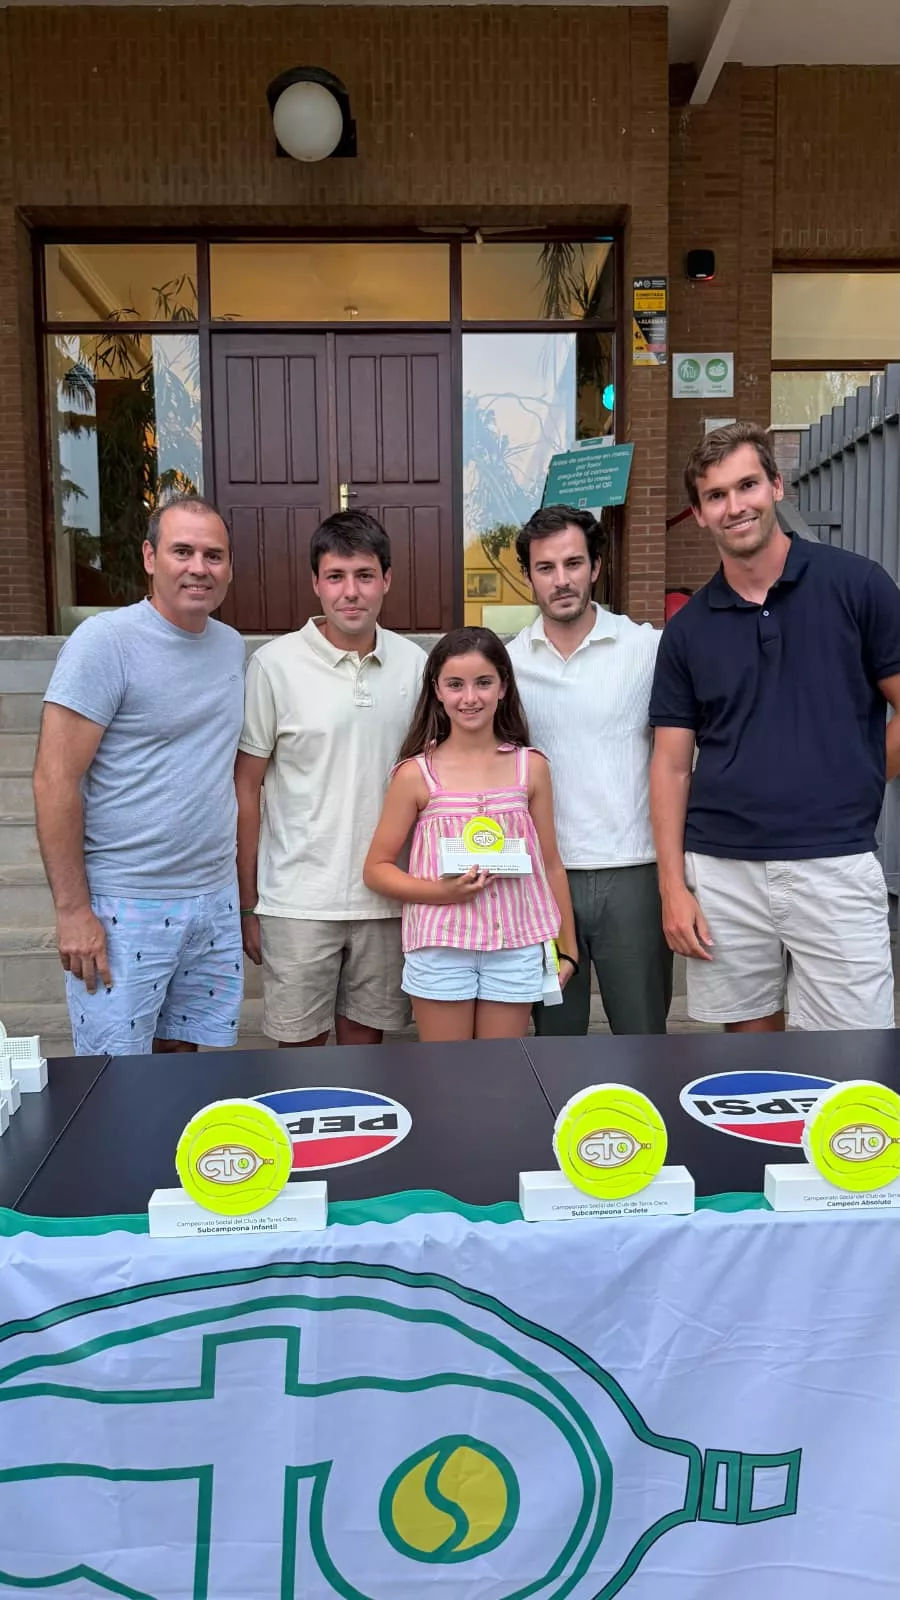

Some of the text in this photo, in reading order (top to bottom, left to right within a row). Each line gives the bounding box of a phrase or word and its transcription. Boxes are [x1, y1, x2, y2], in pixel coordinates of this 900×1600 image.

[576, 461, 602, 471] por favor
[557, 472, 583, 481] pregunte
[590, 467, 619, 475] camarero
[559, 484, 595, 495] escaneando
[692, 1097, 818, 1116] EPSI
[287, 1113, 399, 1135] PEP
[826, 1200, 860, 1208] Campeón
[571, 1208, 622, 1216] Subcampeona
[176, 1220, 214, 1228] Campeonato
[215, 1218, 233, 1226] Social
[197, 1225, 250, 1234] Subcampeona
